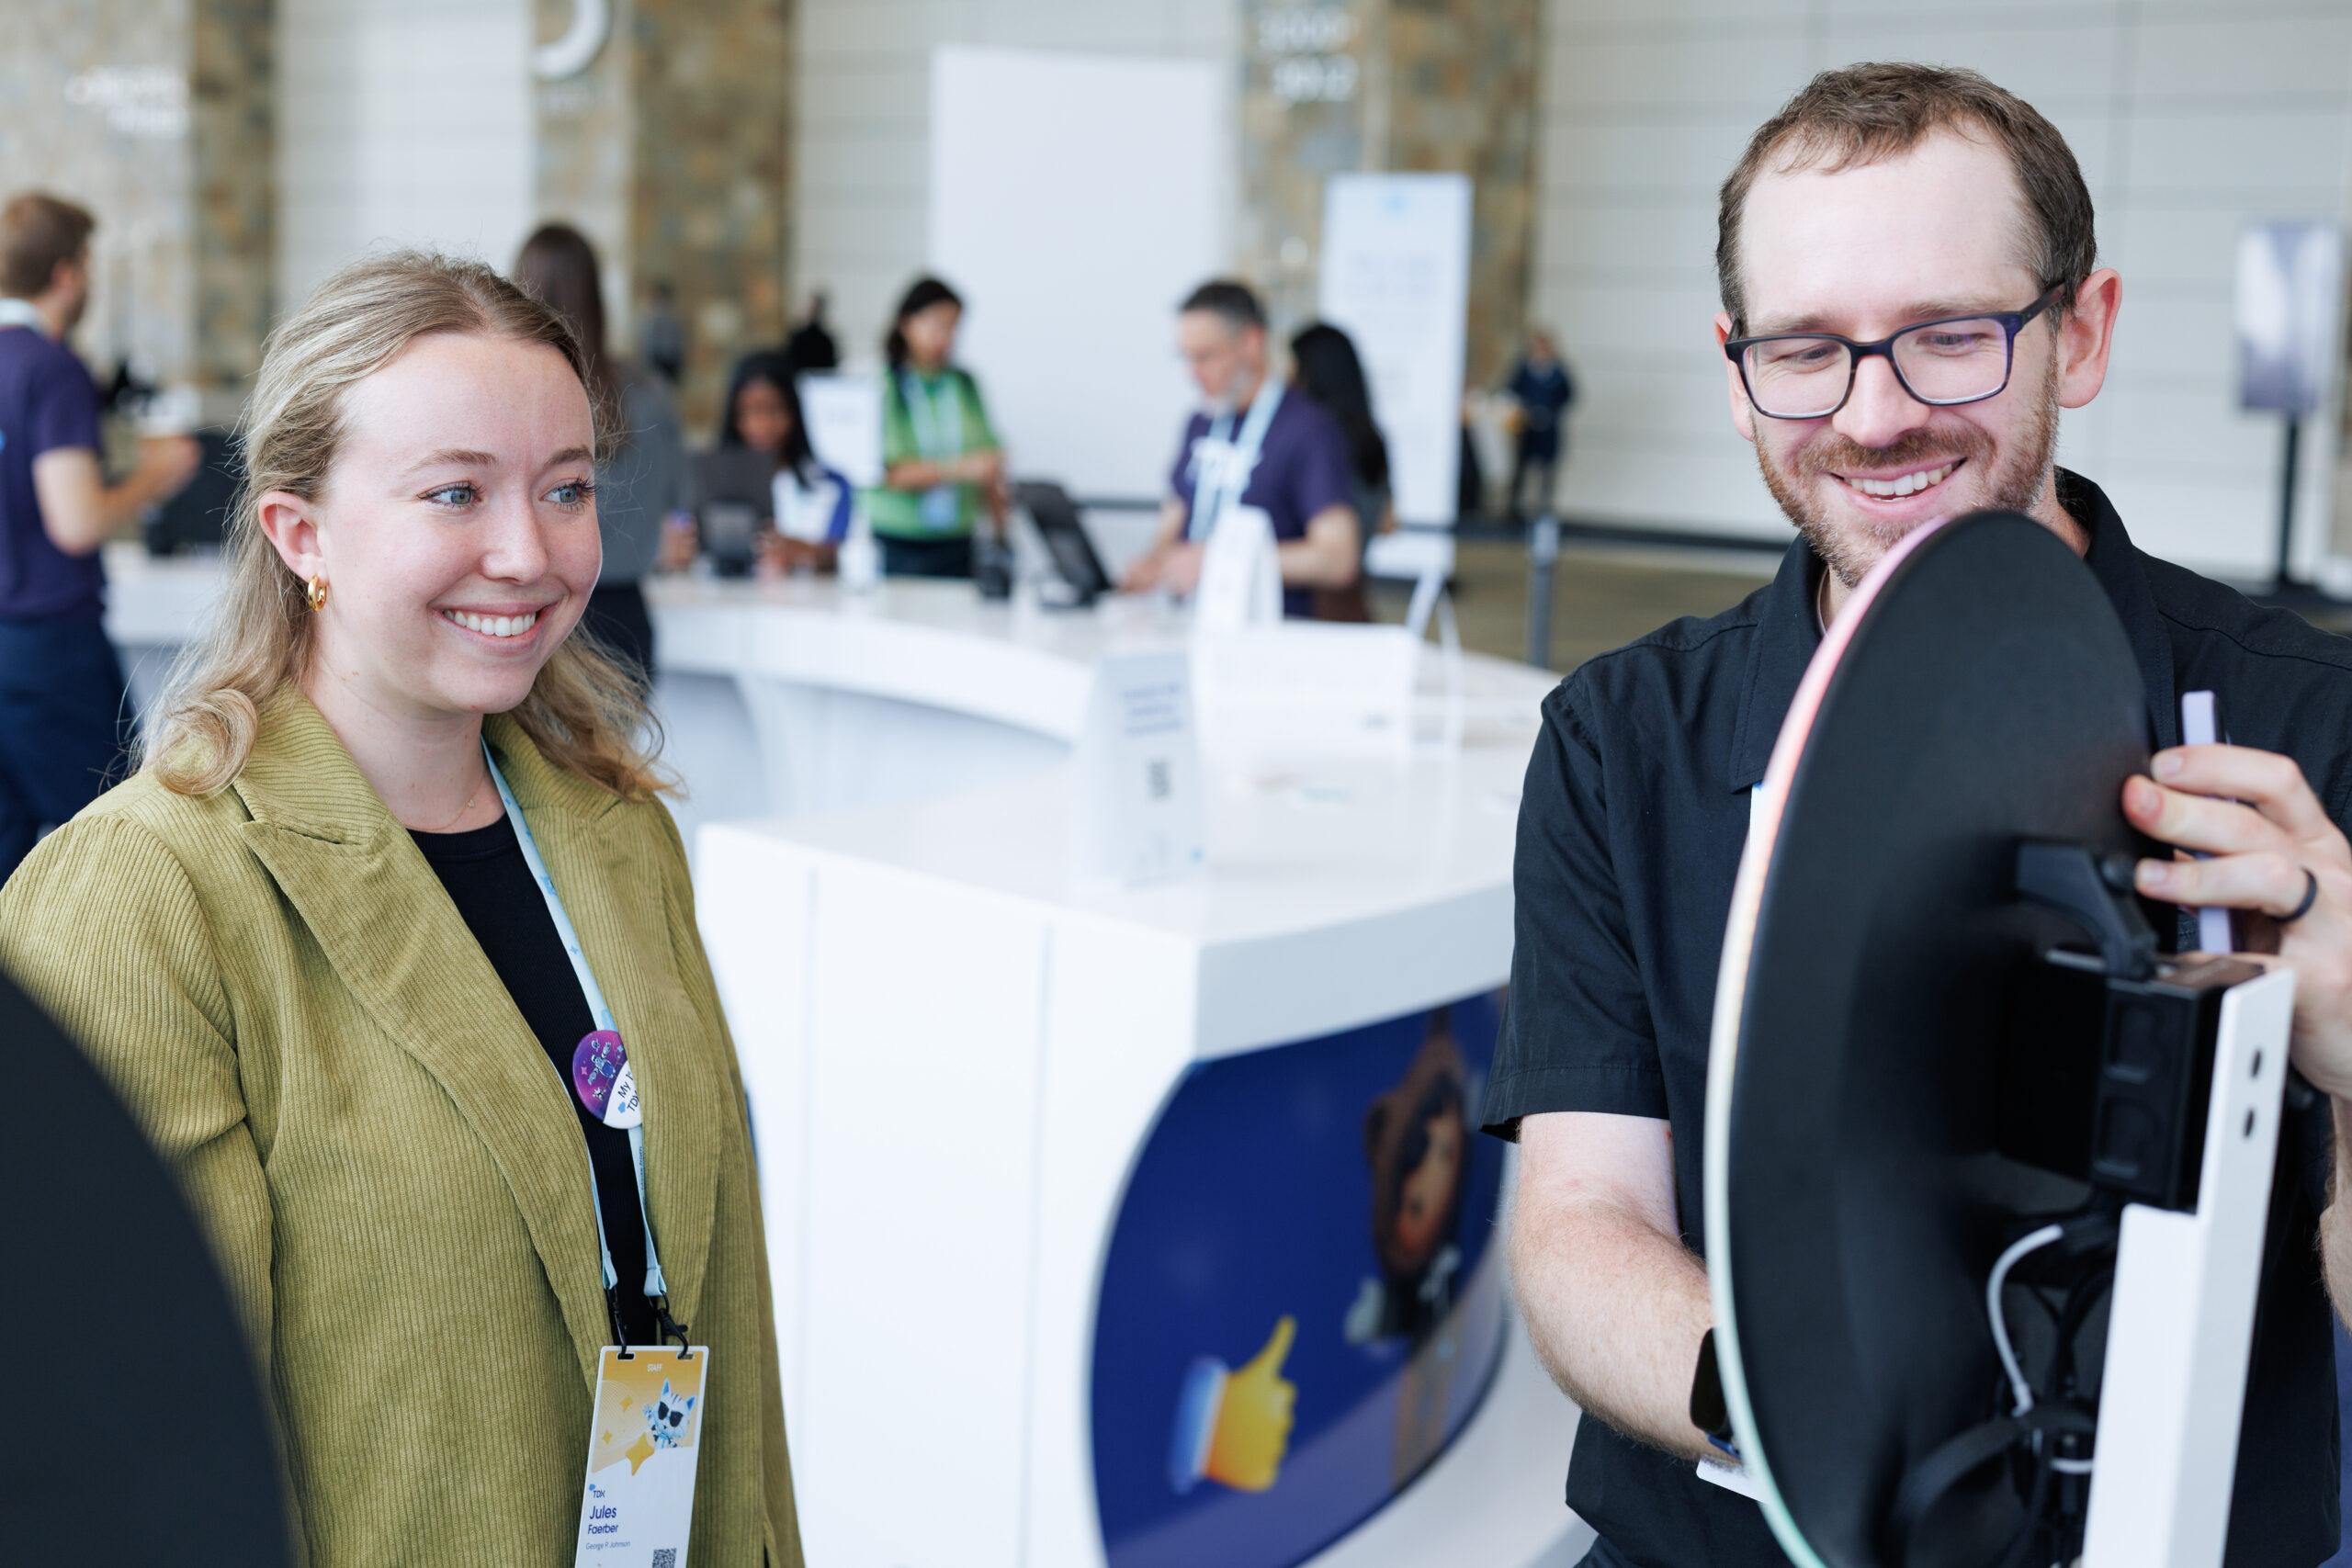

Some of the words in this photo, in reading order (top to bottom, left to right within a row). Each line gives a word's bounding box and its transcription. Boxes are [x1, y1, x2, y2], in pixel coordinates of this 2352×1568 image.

[618, 1081, 631, 1099] My
[589, 1505, 617, 1519] Jules
[587, 1523, 618, 1534] Faerber
